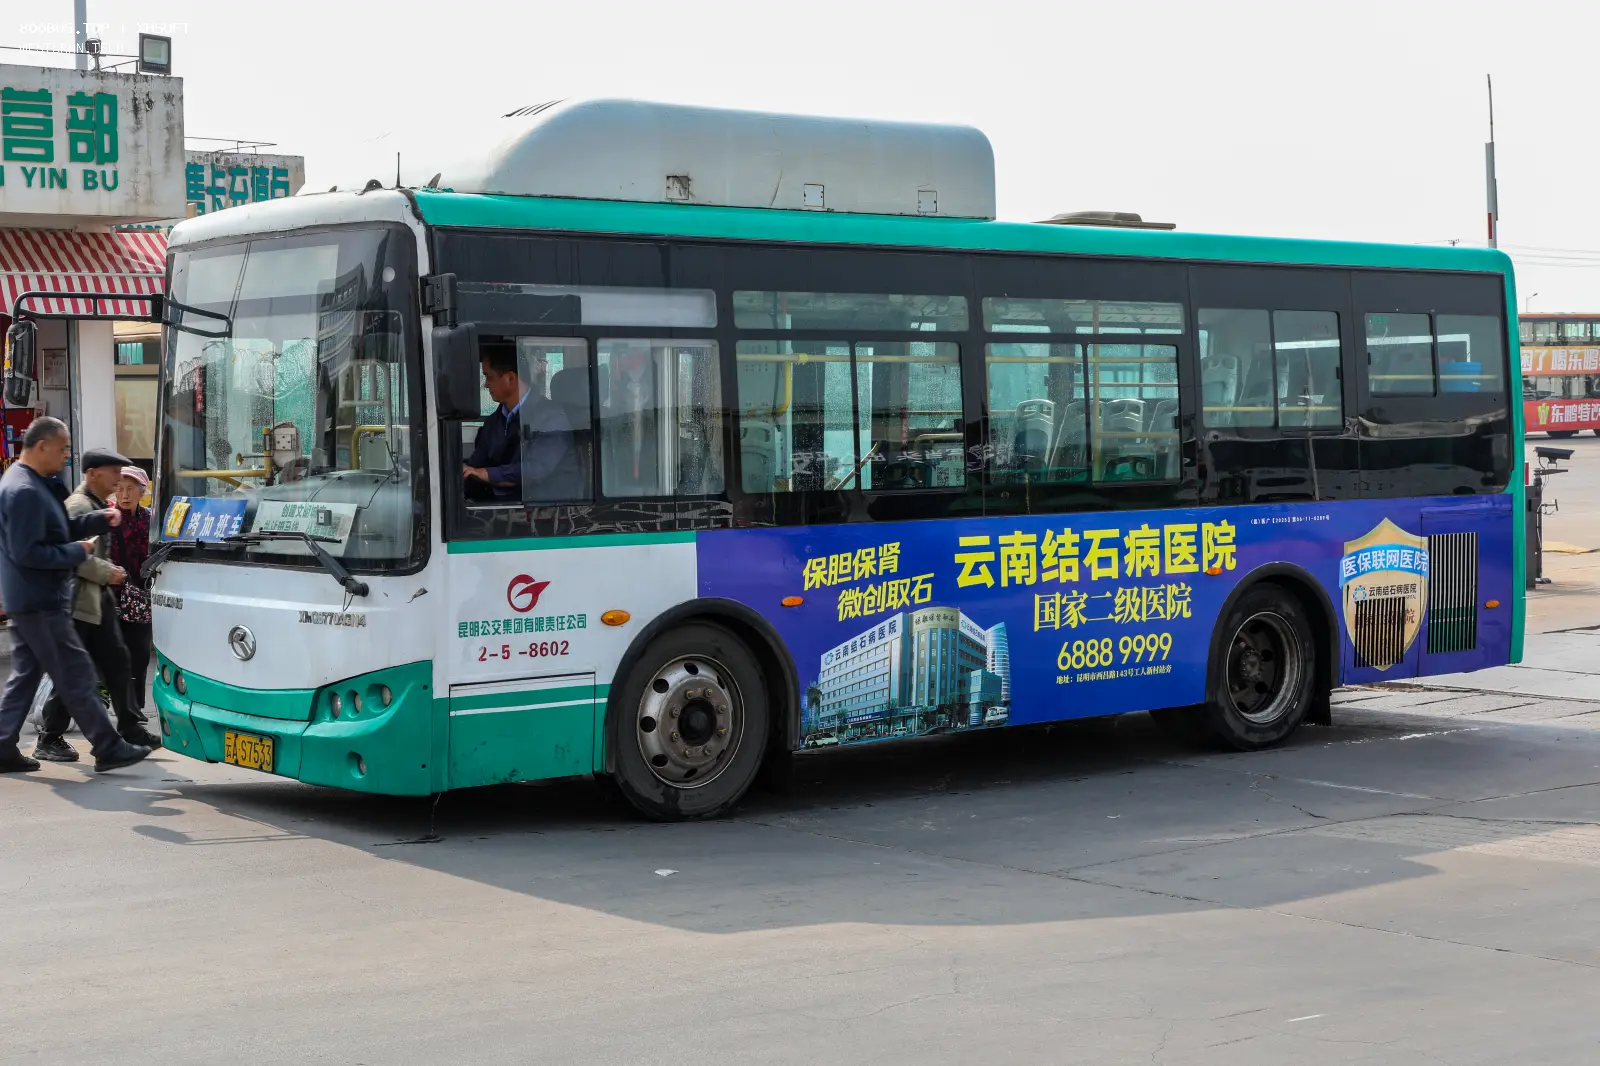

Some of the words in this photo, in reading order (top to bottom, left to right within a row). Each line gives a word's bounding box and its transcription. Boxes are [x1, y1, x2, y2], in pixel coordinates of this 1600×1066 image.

[1, 87, 118, 164] 营部
[21, 166, 67, 188] YIN
[83, 169, 118, 190] BU
[1521, 348, 1600, 372] 困了喝东鹏
[803, 542, 900, 591] 保胆保肾
[955, 520, 1237, 588] 云南结石病医院
[1342, 550, 1429, 577] 医保联网医院
[837, 573, 934, 621] 微创取石
[1034, 583, 1192, 632] 国家二级医院
[458, 613, 587, 638] 昆明公交集团有限责任公司
[1057, 638, 1113, 671] 6888
[1119, 632, 1173, 664] 9999
